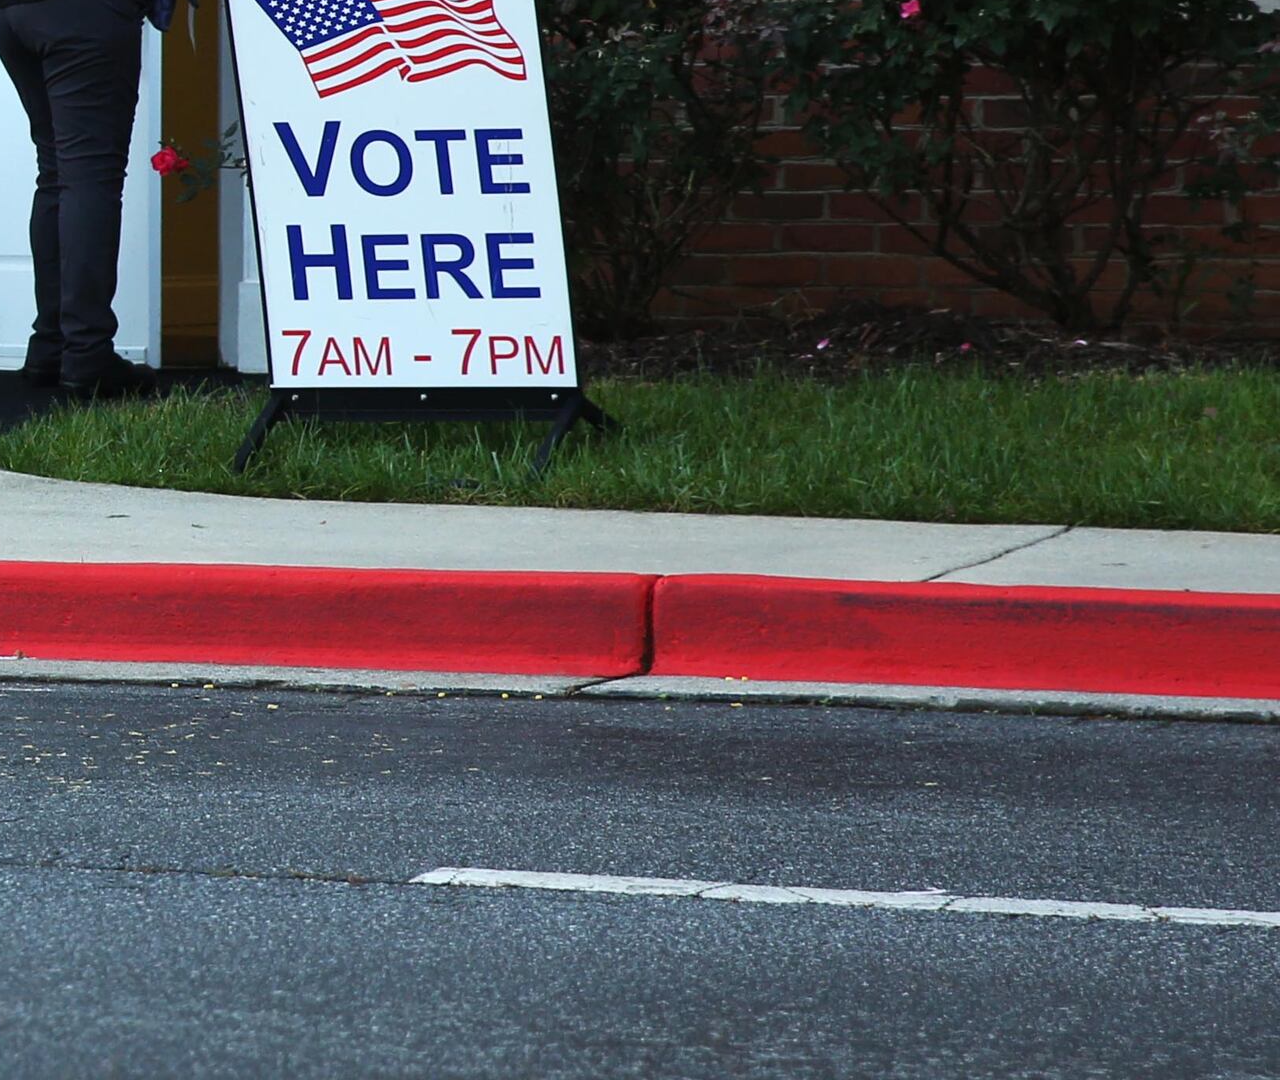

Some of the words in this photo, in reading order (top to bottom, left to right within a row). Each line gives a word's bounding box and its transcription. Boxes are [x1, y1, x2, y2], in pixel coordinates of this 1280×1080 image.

[273, 121, 530, 197] VOTE
[286, 224, 540, 300] HERE
[282, 330, 393, 376] 7AM
[451, 329, 565, 375] 7PM
